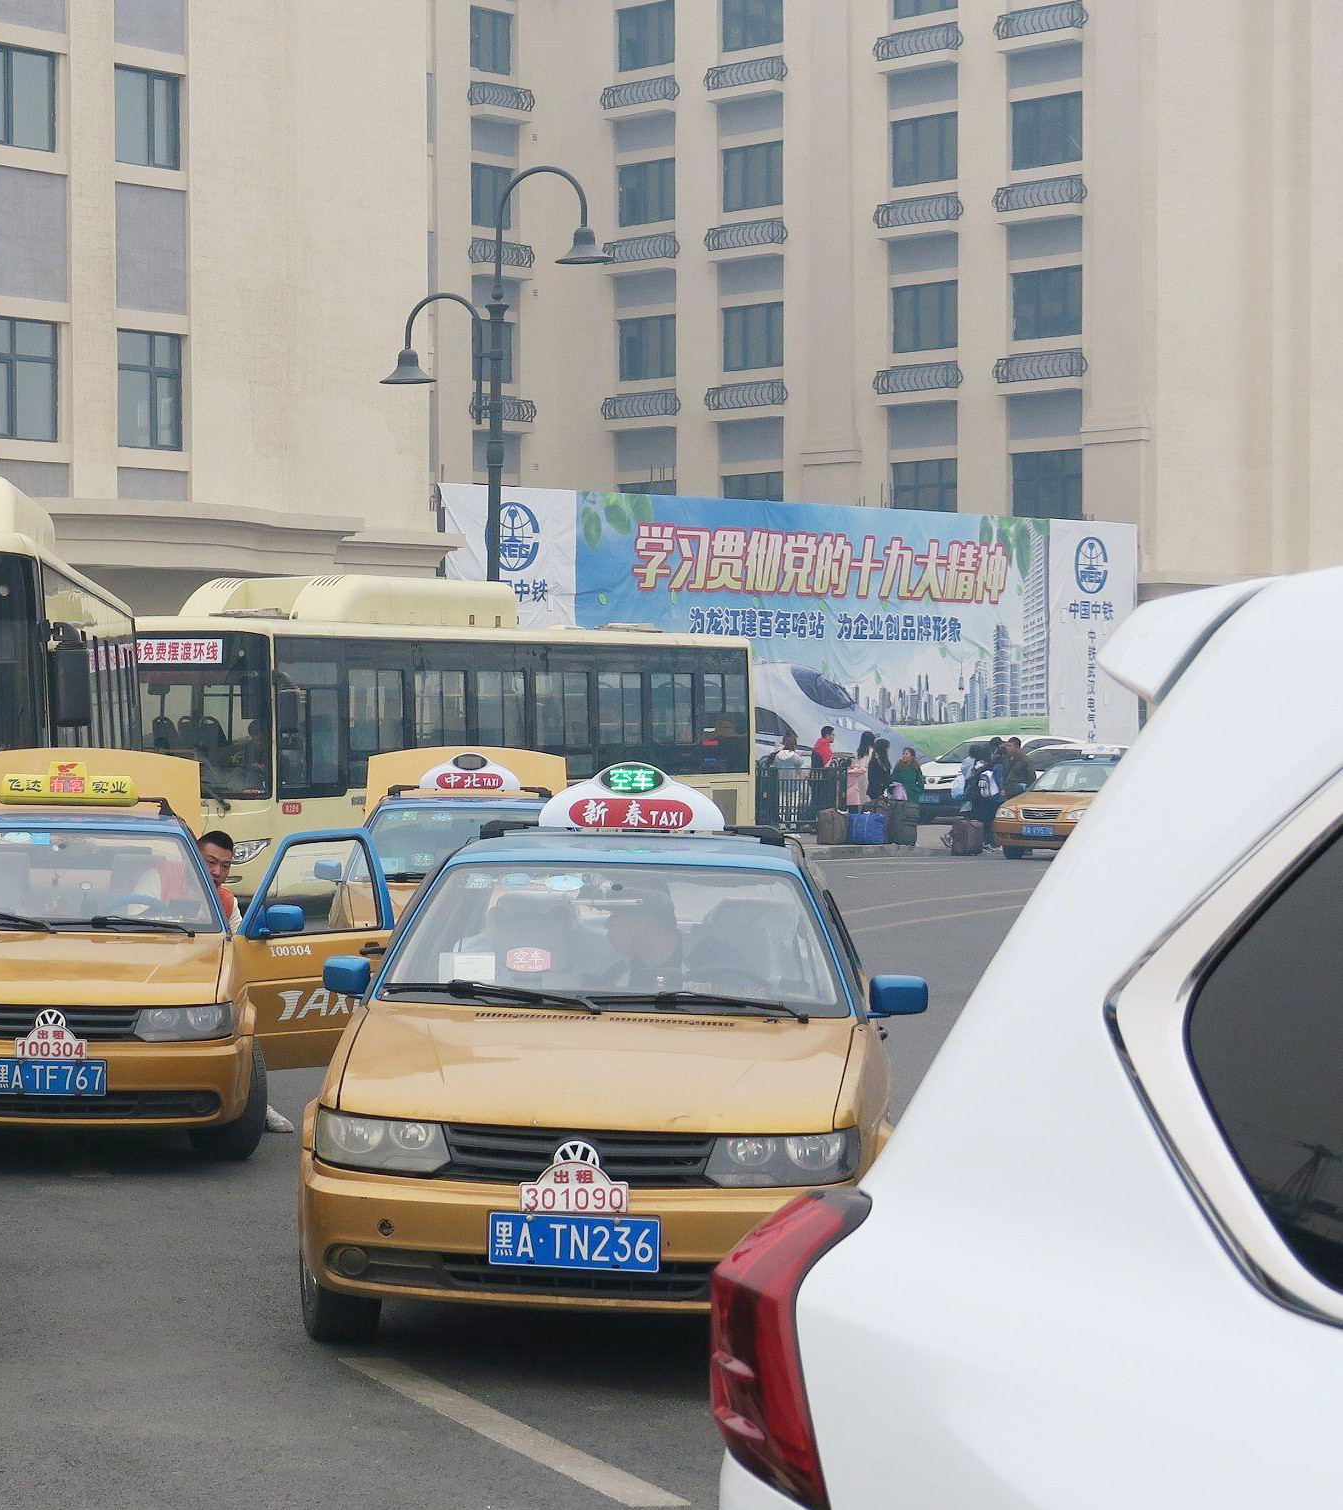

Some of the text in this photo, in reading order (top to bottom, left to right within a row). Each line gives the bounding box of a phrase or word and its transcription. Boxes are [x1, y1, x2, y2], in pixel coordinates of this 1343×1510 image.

[632, 521, 1008, 605] 学习贯彻党的十九大精神
[499, 578, 548, 602] 中铁
[1069, 599, 1114, 620] 中国中铁
[689, 607, 962, 642] 为龙江建百年哈站 为企业创品牌形象
[8, 777, 128, 794] 飞达 有客 实业
[444, 773, 499, 789] 中北 TAXI
[609, 768, 655, 791] 空车
[582, 799, 684, 827] 新春 TAXI
[269, 944, 312, 958] 100304
[514, 949, 544, 964] 空车
[277, 987, 361, 1021] TAXI
[37, 1029, 65, 1040] 出租
[17, 1040, 85, 1058] 100304
[553, 1169, 594, 1184] 出租
[524, 1187, 624, 1211] 301090
[494, 1221, 654, 1263] 黑A·TN236
